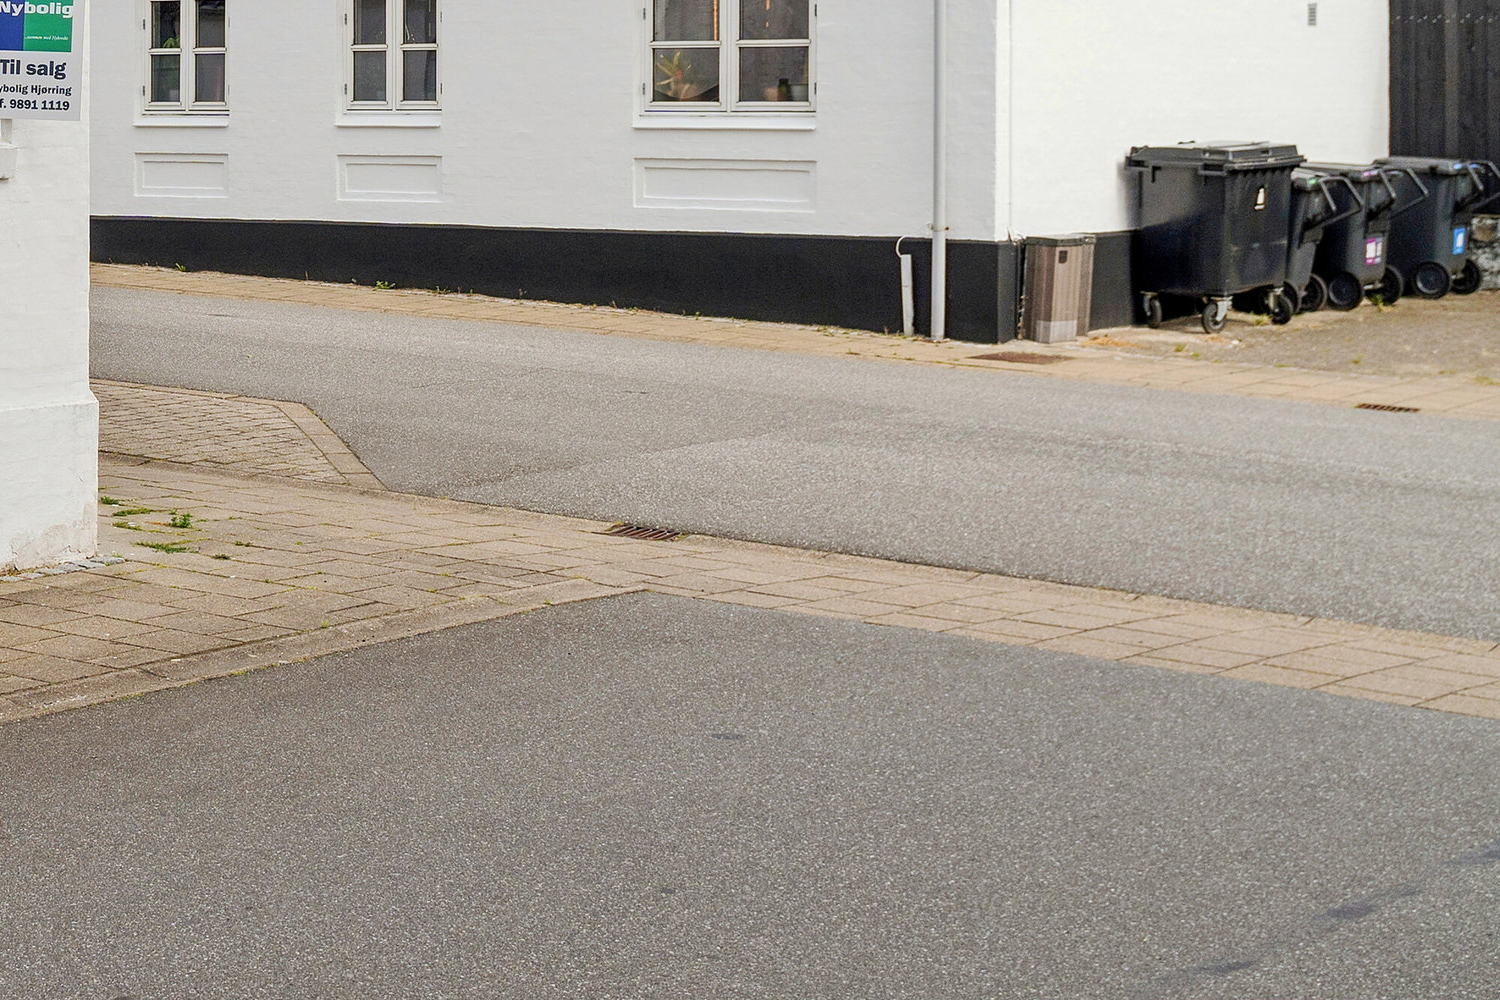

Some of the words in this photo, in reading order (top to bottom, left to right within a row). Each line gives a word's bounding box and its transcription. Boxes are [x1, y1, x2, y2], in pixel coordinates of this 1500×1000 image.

[0, 59, 21, 75] Til
[26, 60, 67, 80] salg
[31, 85, 72, 97] Hjørring
[10, 99, 38, 110] 9891
[41, 100, 70, 111] 1119
